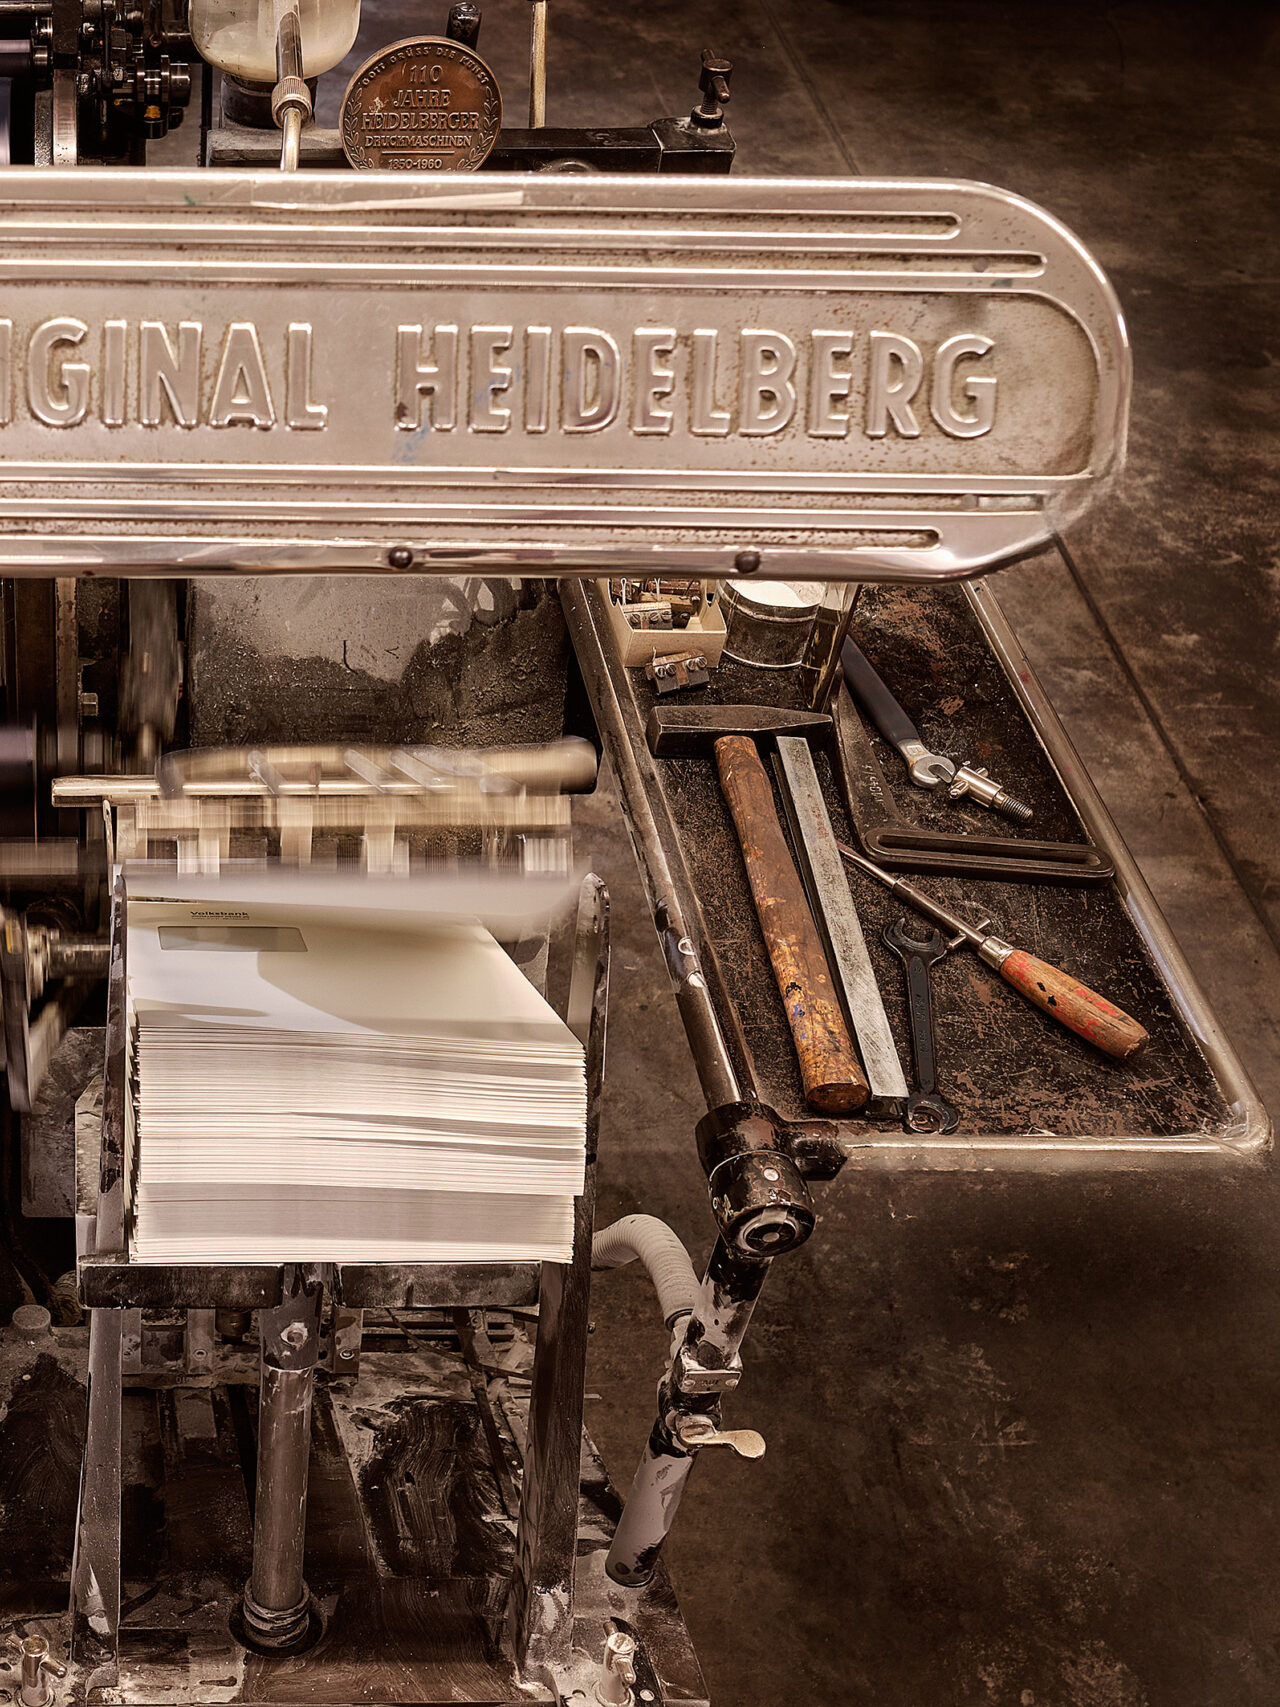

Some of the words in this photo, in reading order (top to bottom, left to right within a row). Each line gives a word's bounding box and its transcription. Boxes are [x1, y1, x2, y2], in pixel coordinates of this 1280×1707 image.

[361, 62, 386, 86] GOTT
[436, 47, 457, 60] DIE
[459, 55, 490, 85] KUNST
[409, 64, 444, 85] 110
[393, 89, 452, 109] JAHRE
[360, 112, 480, 132] HEIDELBERGER
[364, 135, 473, 149] DRUCKMASCHINEN
[388, 158, 443, 170] 1850-1960
[392, 323, 999, 441] HEIDELBERG
